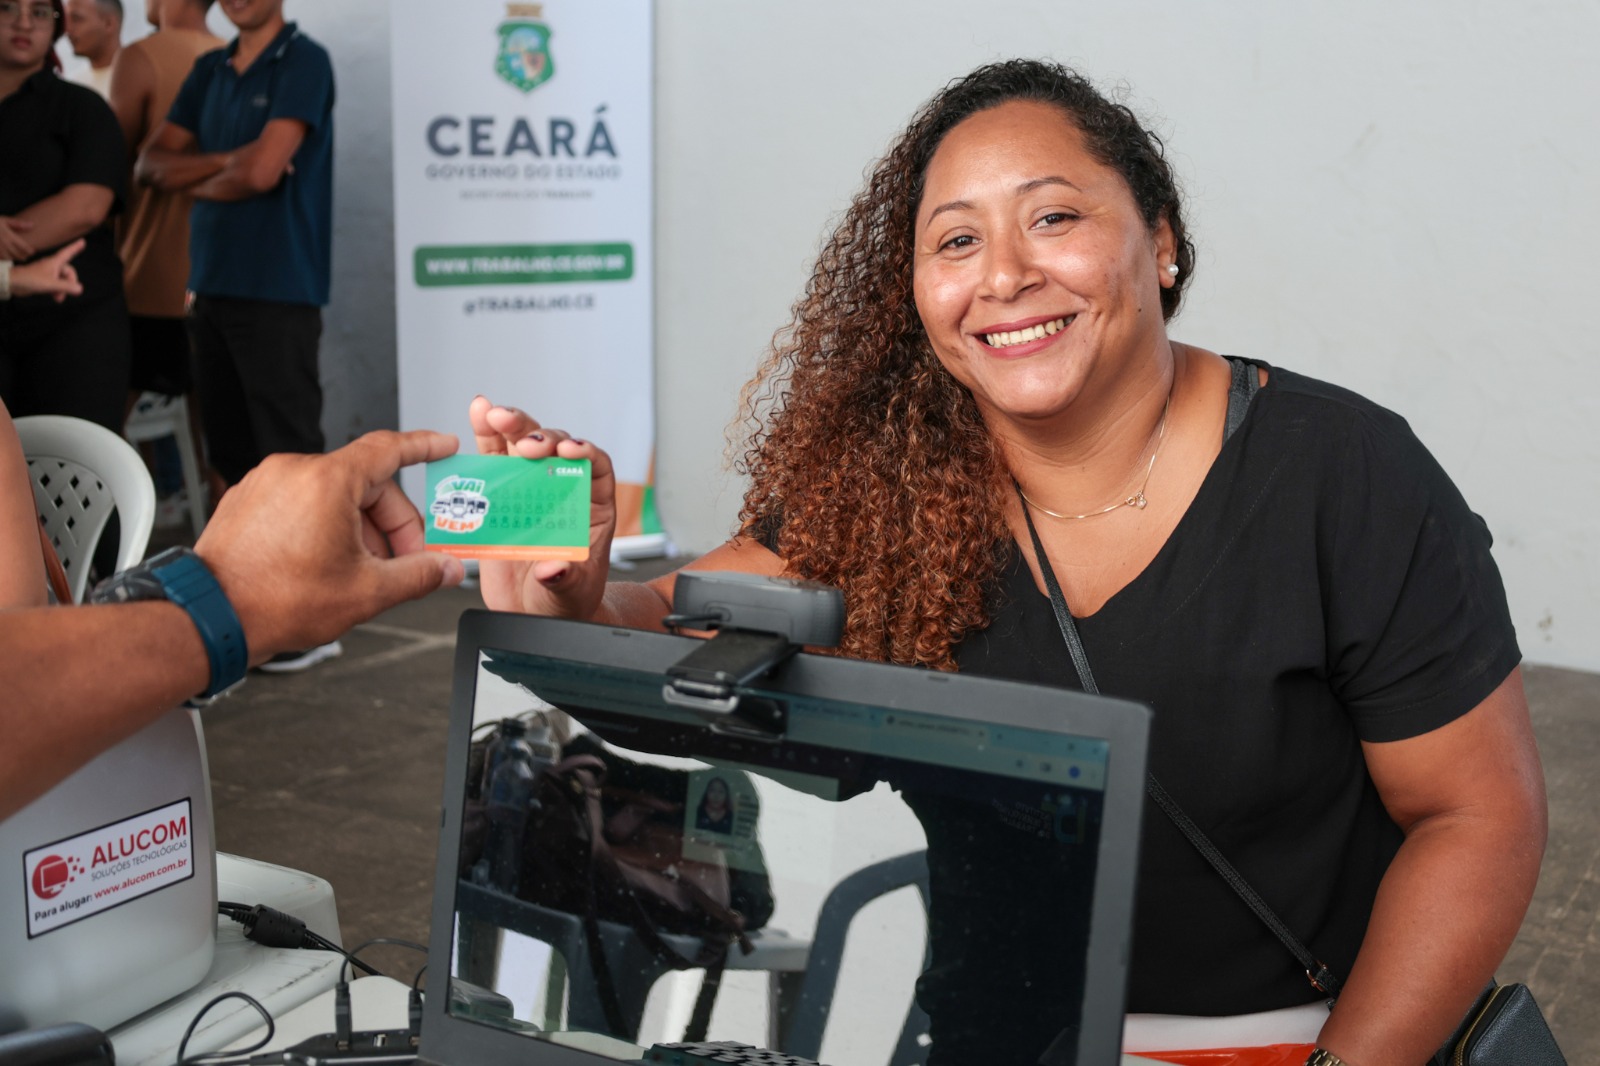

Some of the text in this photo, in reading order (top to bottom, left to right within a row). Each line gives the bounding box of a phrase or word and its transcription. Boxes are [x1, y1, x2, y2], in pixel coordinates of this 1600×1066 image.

[425, 105, 618, 158] CEARÁ
[425, 163, 621, 180] GOVERNO DO ESTADO
[556, 466, 584, 475] CEARÁ
[436, 516, 474, 531] VEM
[91, 816, 187, 868] ALUCOM
[91, 840, 187, 882] SOLUÇÕES TECNOLÓGICAS
[34, 858, 188, 921] Para alugar: www.alucom.com.br
